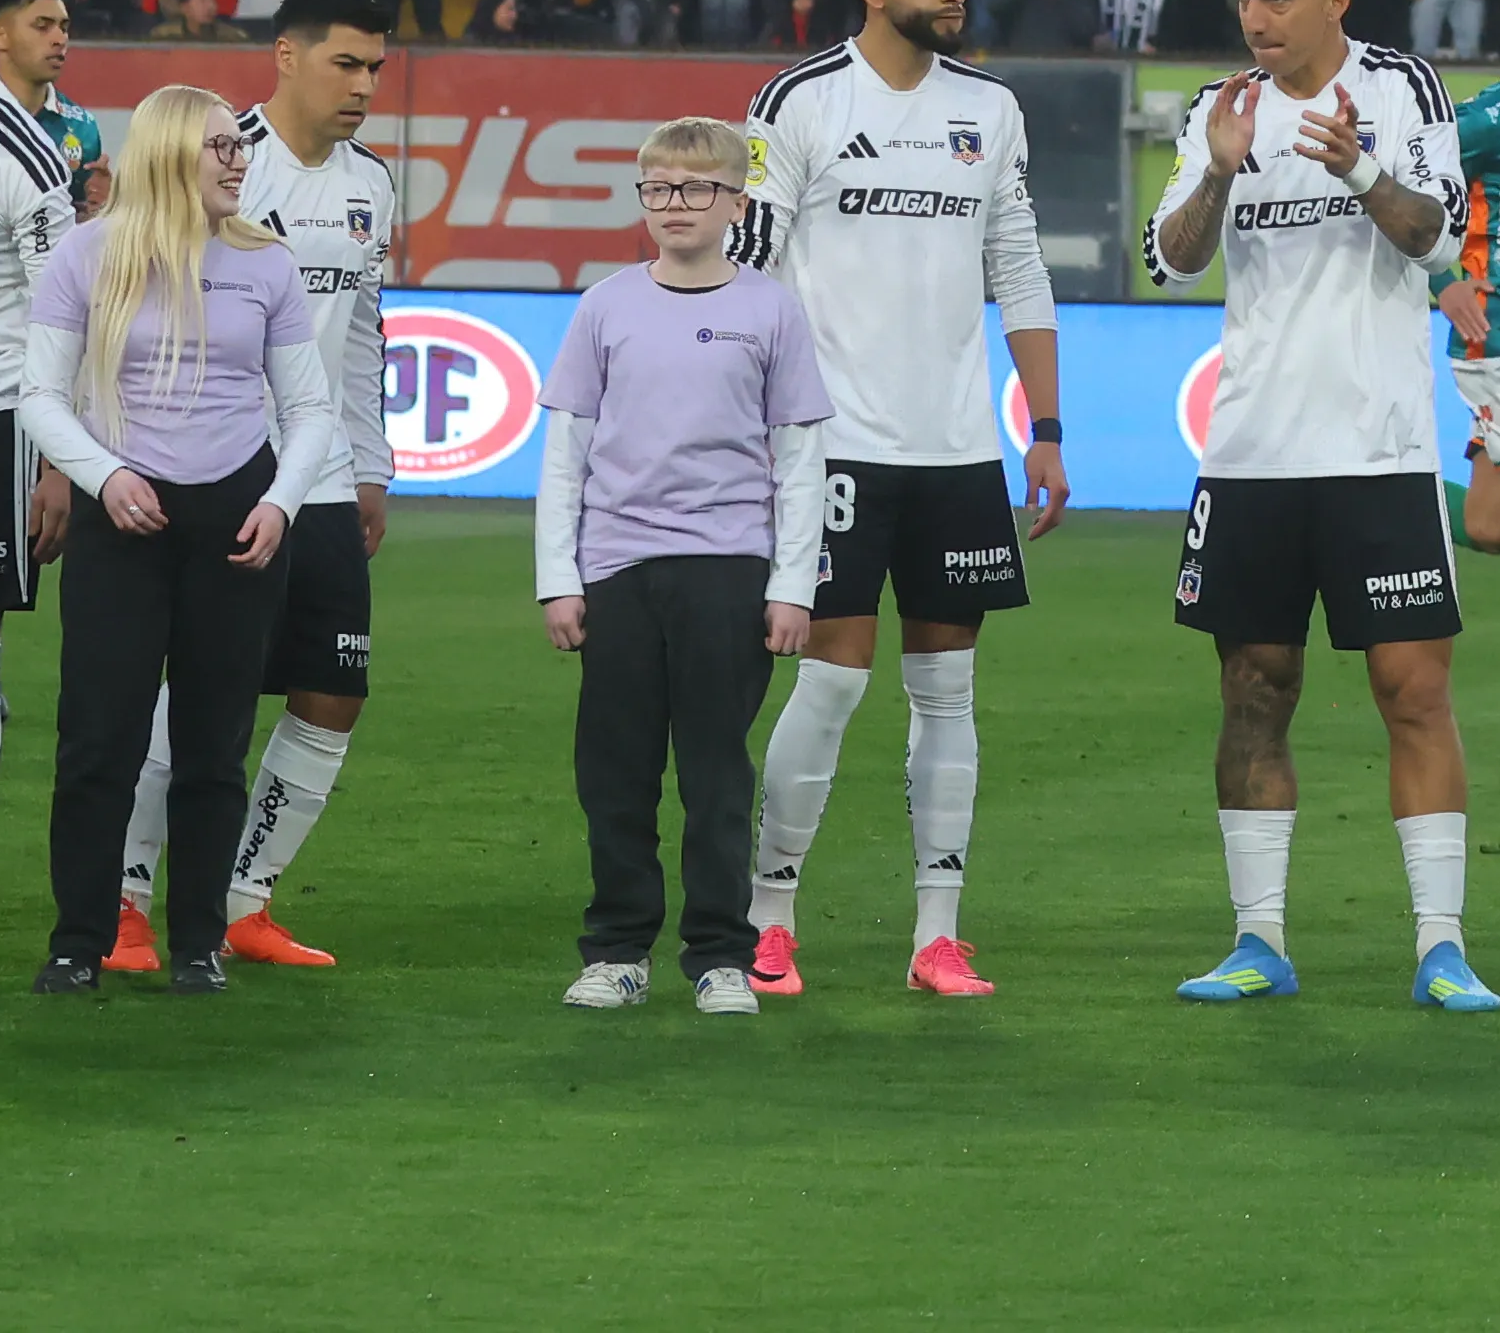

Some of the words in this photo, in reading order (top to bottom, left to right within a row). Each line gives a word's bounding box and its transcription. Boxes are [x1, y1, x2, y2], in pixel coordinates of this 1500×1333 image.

[882, 139, 946, 150] JETOUR
[288, 219, 345, 229] JETOUR
[1187, 489, 1211, 550] 9
[944, 546, 1013, 569] PHILIPS
[945, 571, 966, 584] TV
[968, 570, 979, 584] &
[982, 566, 1015, 583] Audio
[1365, 568, 1443, 595] PHILIPS
[1370, 596, 1389, 611] TV
[1390, 595, 1402, 609] &
[1405, 589, 1444, 607] Audio
[337, 653, 355, 668] TV
